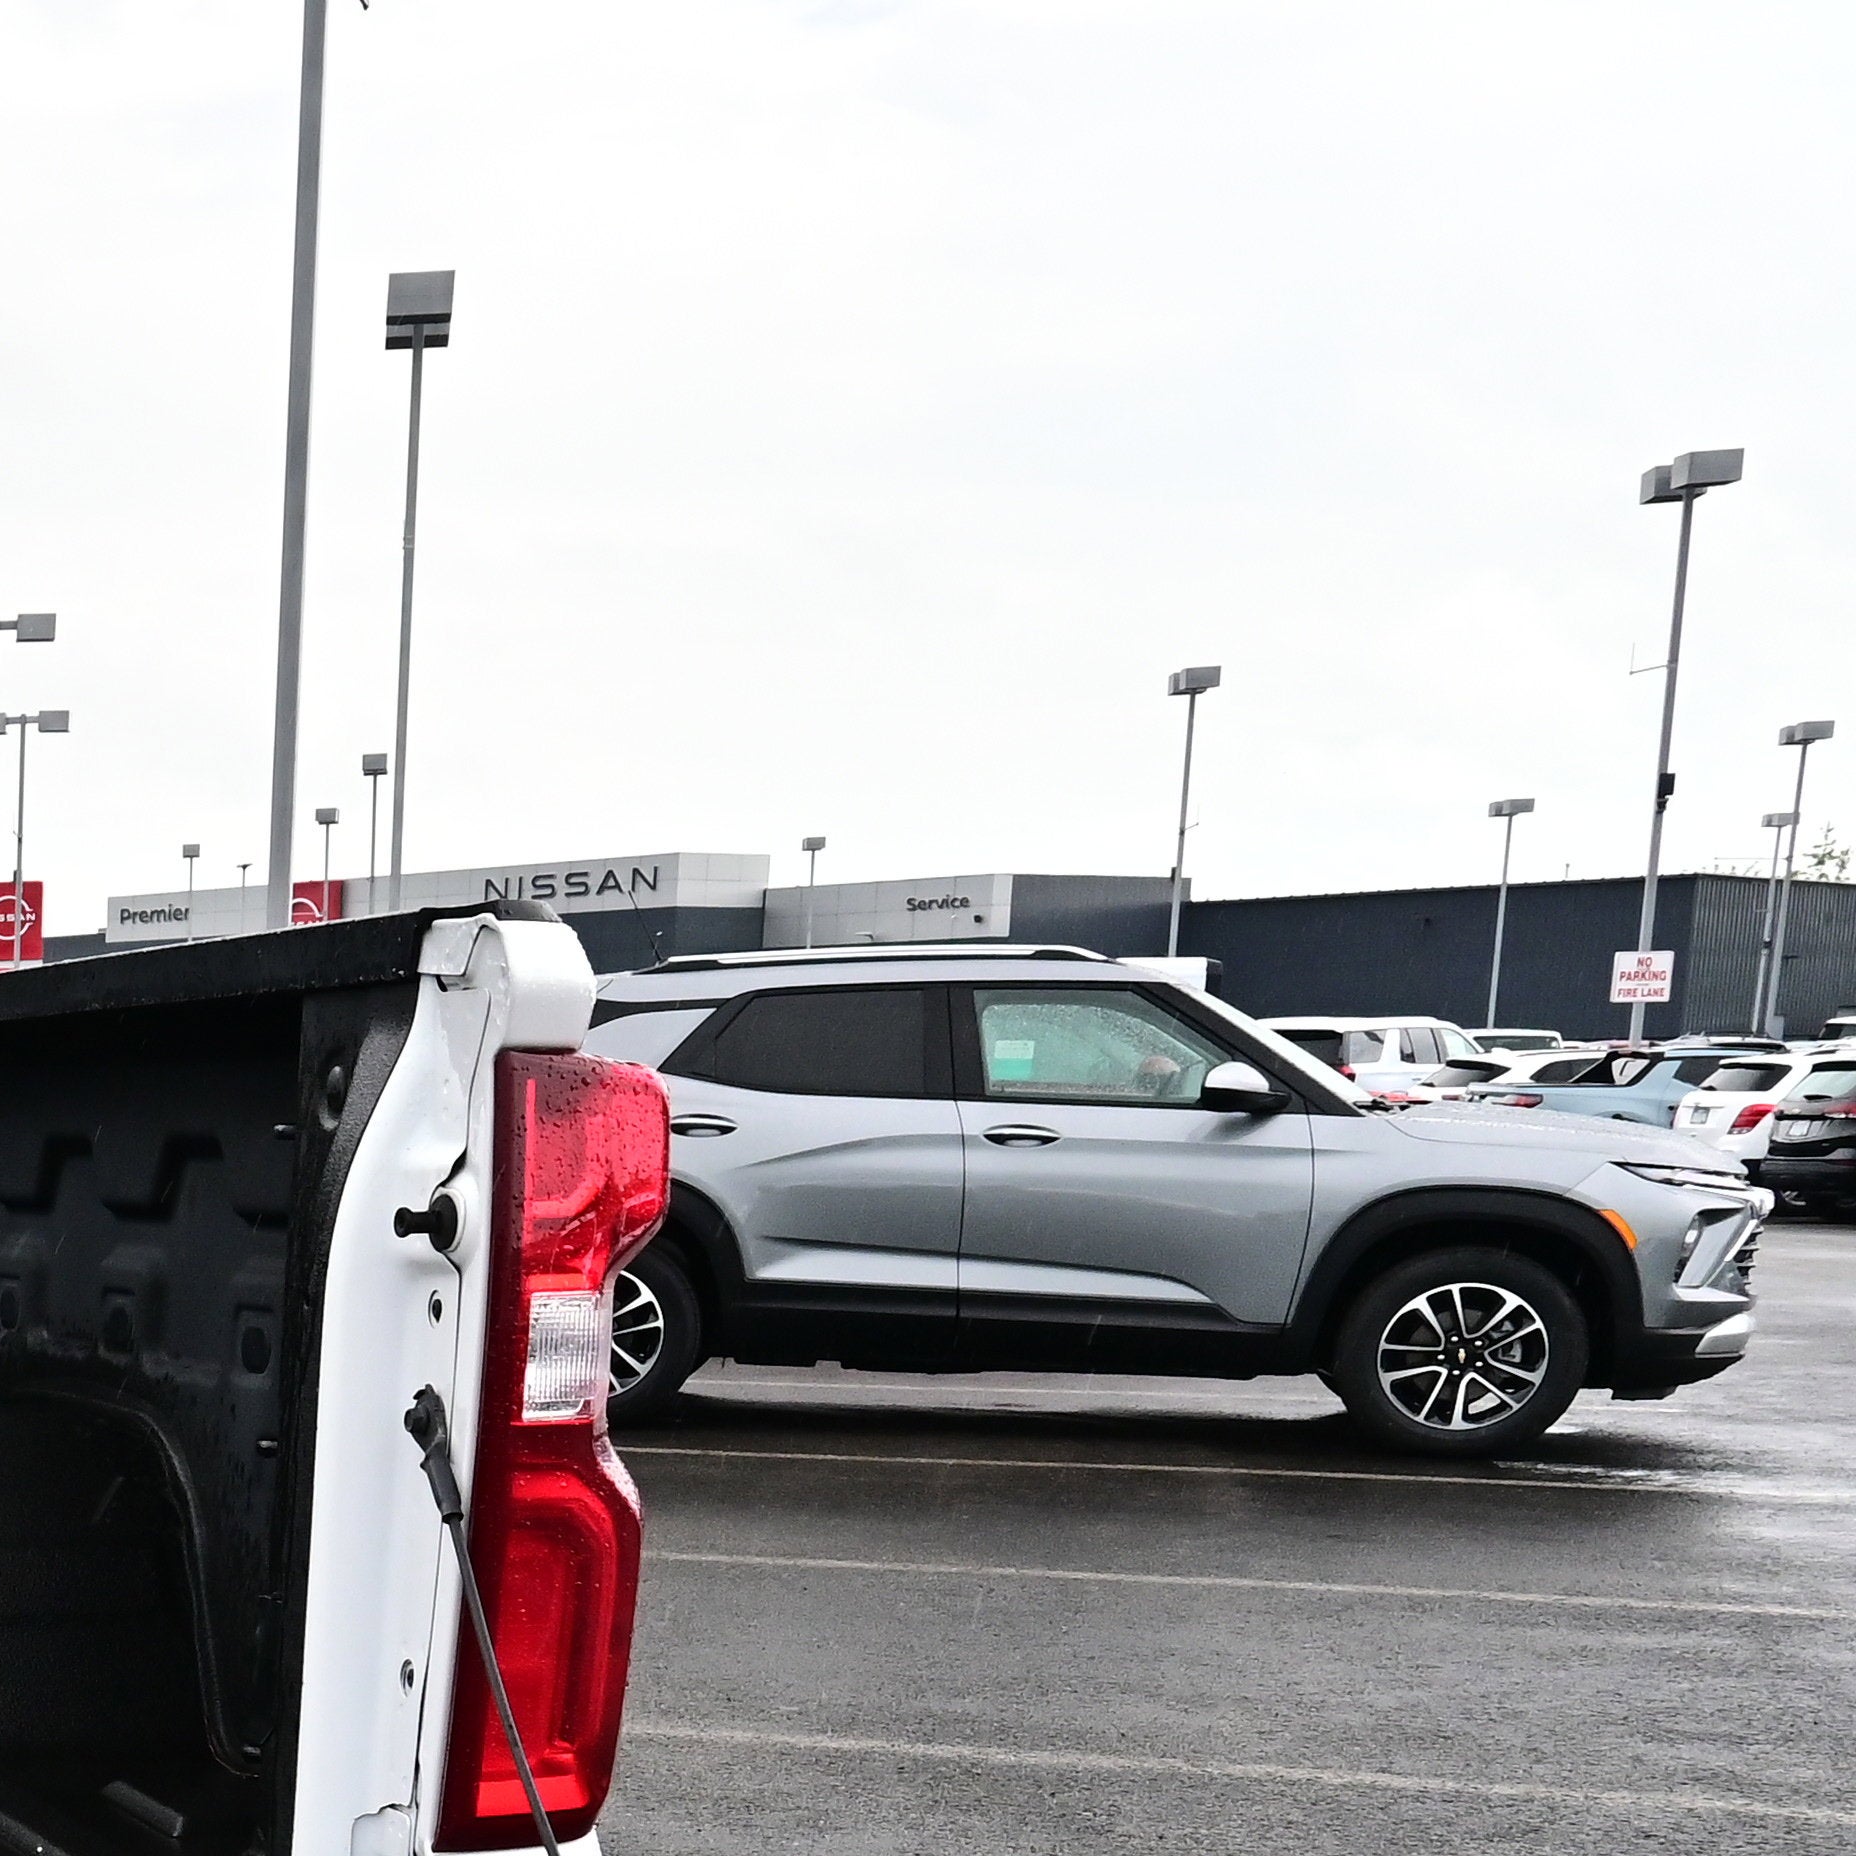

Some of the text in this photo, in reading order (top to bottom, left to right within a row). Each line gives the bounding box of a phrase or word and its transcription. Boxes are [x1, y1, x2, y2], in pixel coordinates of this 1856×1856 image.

[484, 866, 659, 901] NISSAN
[906, 894, 971, 912] Service
[119, 903, 190, 925] Premier
[1637, 957, 1653, 968] NO
[1619, 970, 1667, 982] PARKING
[1617, 987, 1666, 998] FIRE LANE
